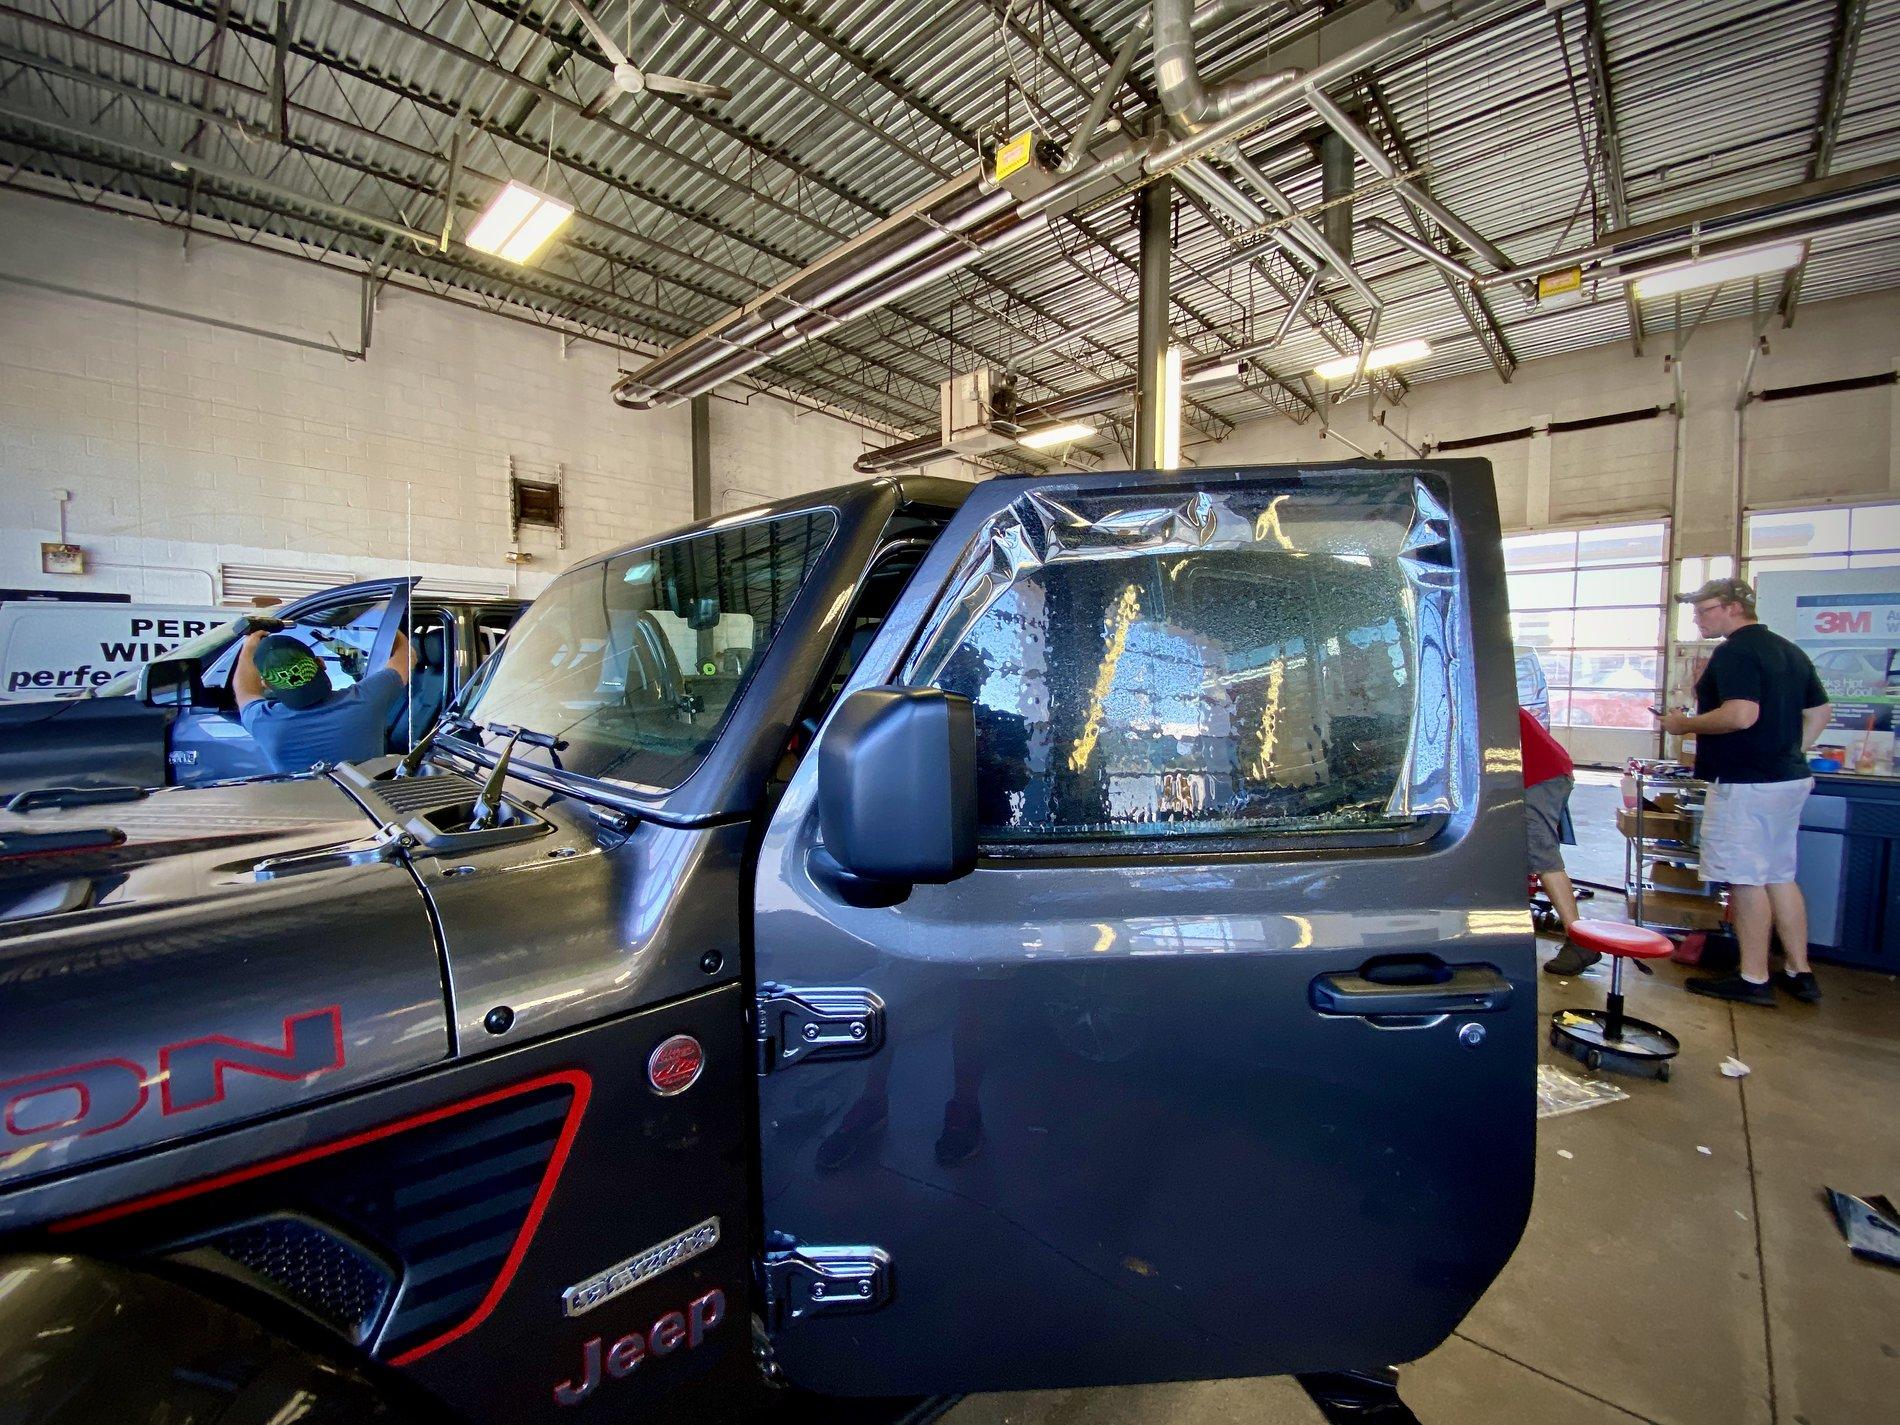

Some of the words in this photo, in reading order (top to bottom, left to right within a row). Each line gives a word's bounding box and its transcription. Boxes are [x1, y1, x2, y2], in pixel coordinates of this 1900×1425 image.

[1814, 611, 1872, 634] 3M
[8, 665, 128, 692] perfe
[554, 1288, 726, 1406] Jeep
